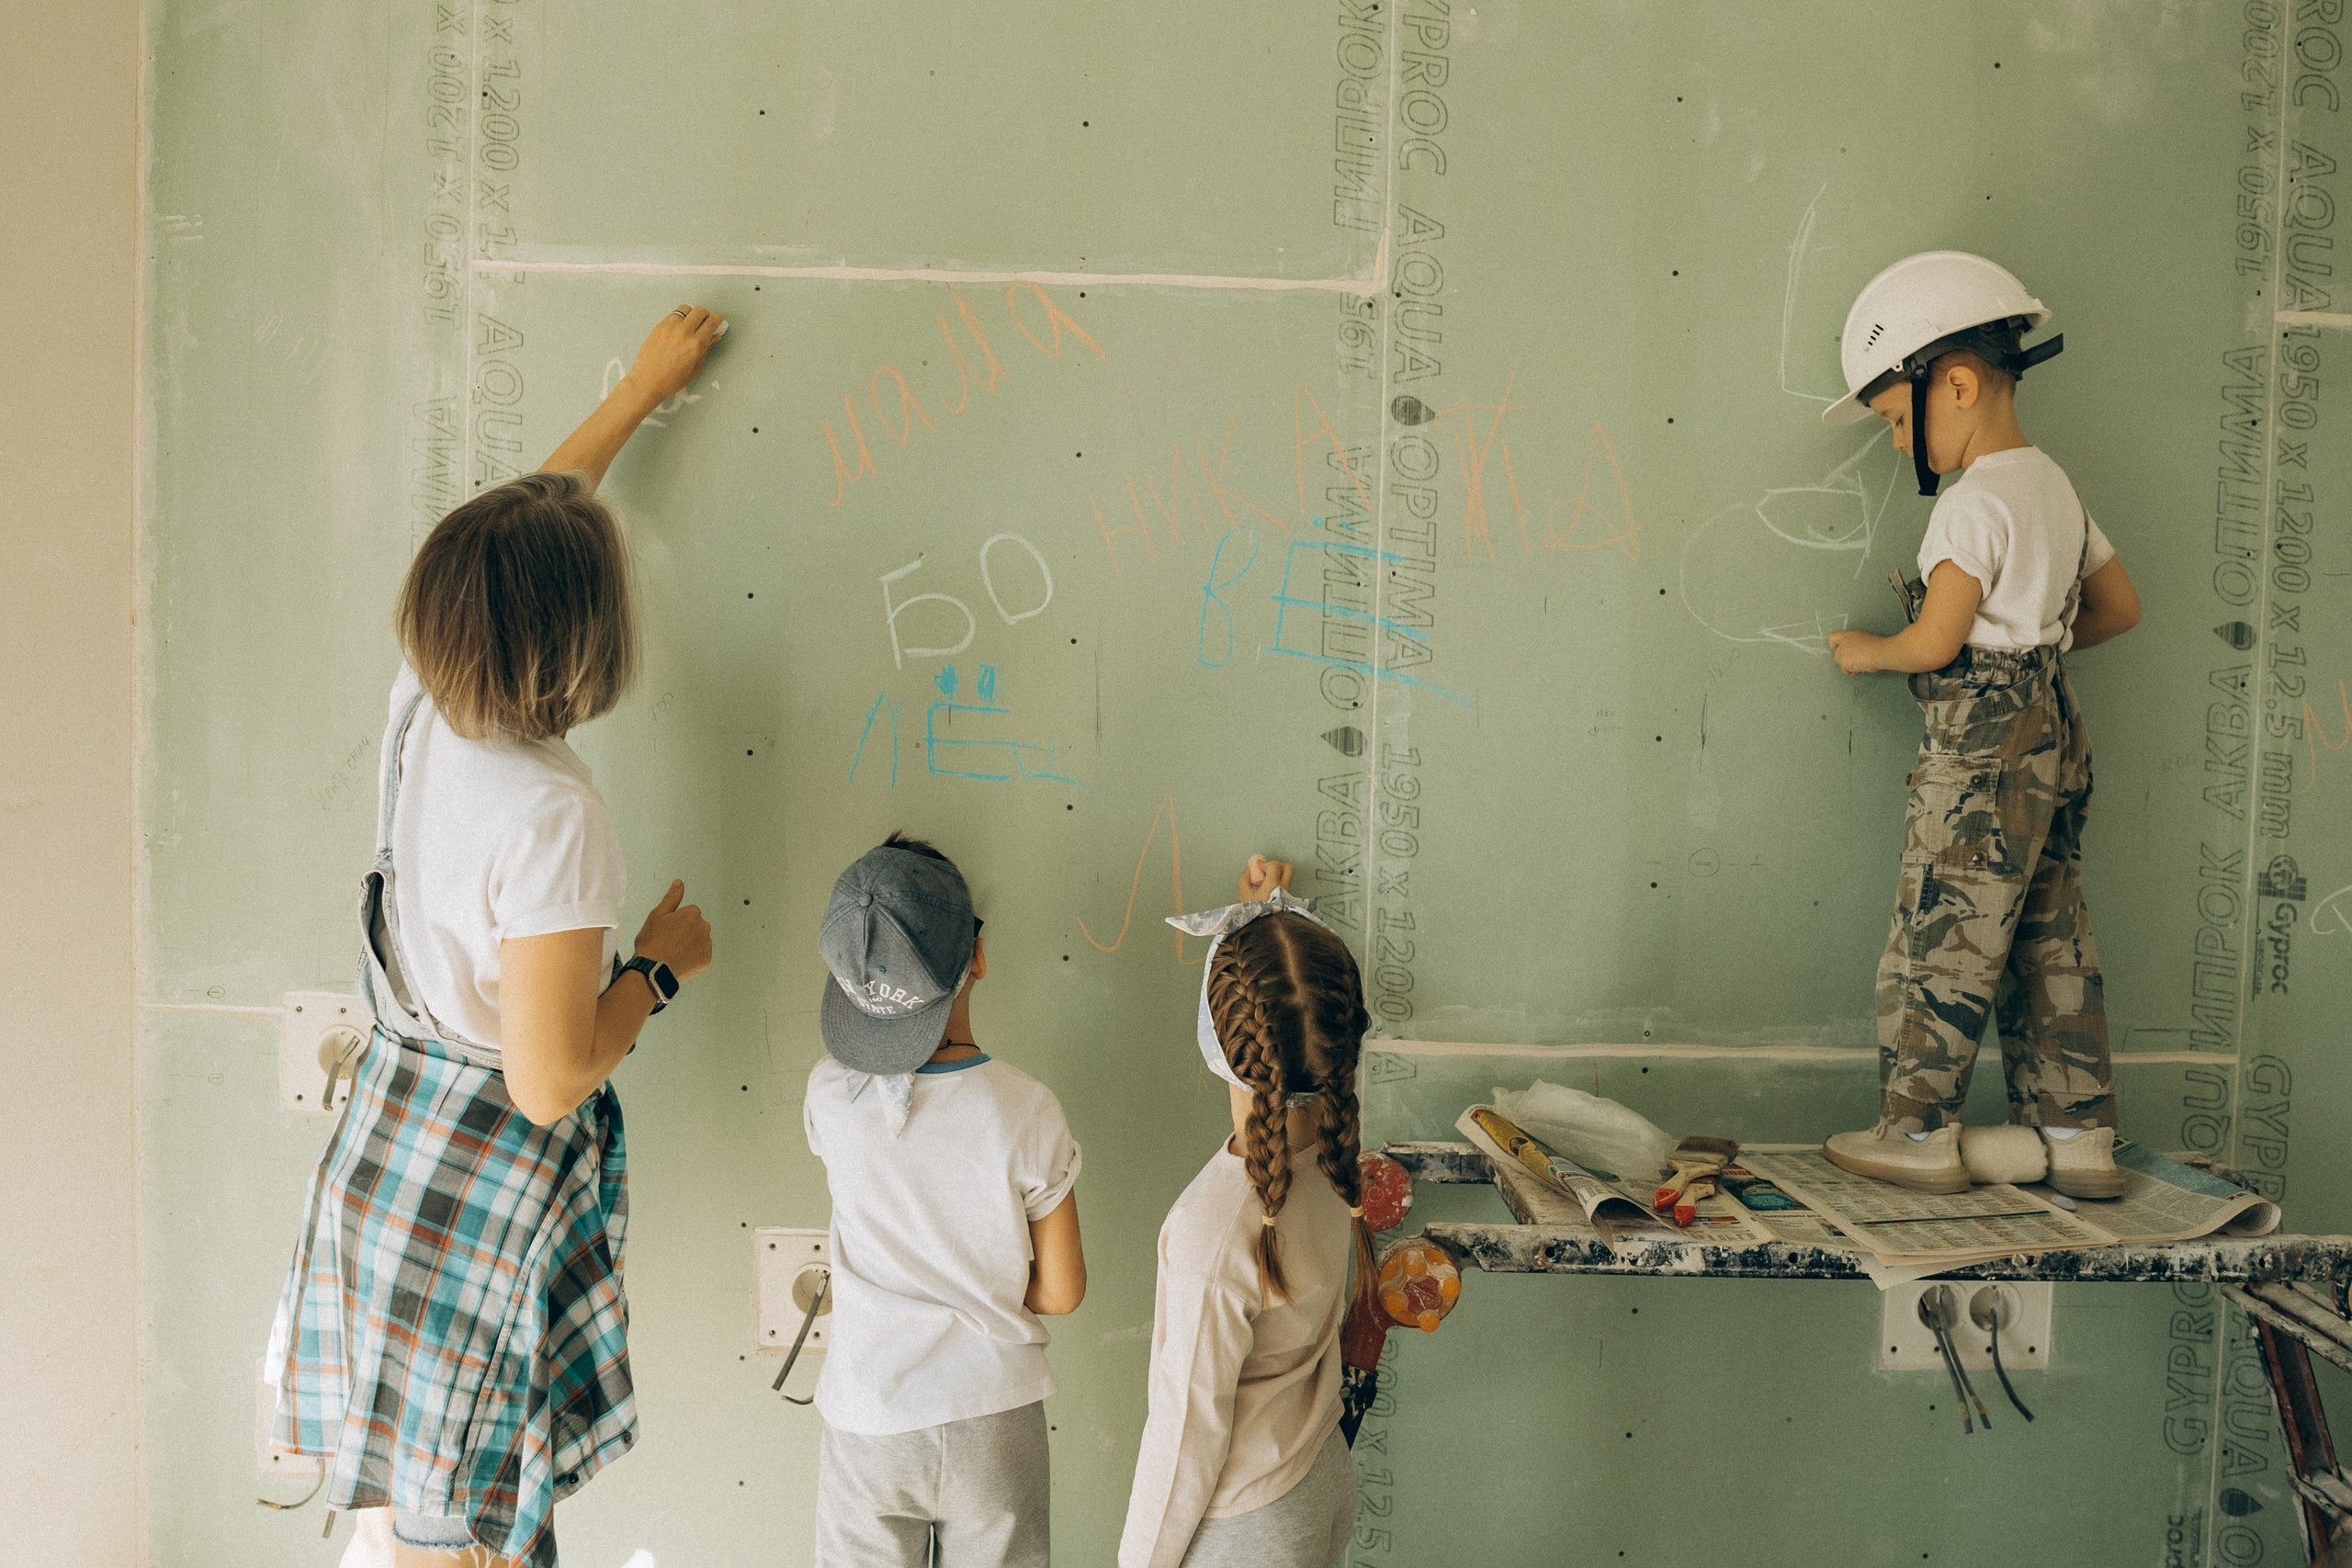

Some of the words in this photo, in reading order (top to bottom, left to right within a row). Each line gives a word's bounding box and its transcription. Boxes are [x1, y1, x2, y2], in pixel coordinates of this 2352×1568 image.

[426, 46, 468, 163] 1200
[481, 56, 521, 171] 1200
[2241, 0, 2280, 116] 1200
[424, 213, 461, 331] 1950
[2235, 165, 2275, 282] 1950
[2284, 141, 2337, 314] AQUA
[1392, 204, 1444, 383] AQUA
[472, 312, 524, 492] AQUA
[2278, 324, 2321, 431] 1950
[2213, 344, 2267, 607] ОПТИМА
[1319, 446, 1372, 710] ОПТИМА
[1385, 434, 1439, 671] OPTIMA
[2272, 479, 2314, 593] 1200
[2203, 663, 2251, 820] АКВА
[2265, 642, 2308, 740] 12.5
[1315, 771, 1363, 931] АКВА
[1379, 742, 1421, 858] 1950
[2259, 751, 2293, 839] mm
[864, 980, 925, 1010] YORK
[1374, 907, 1416, 1023] 1200
[2190, 841, 2245, 1051] ИПРОК
[2267, 902, 2298, 996] Gyproc
[2242, 1054, 2292, 1205] GYPR
